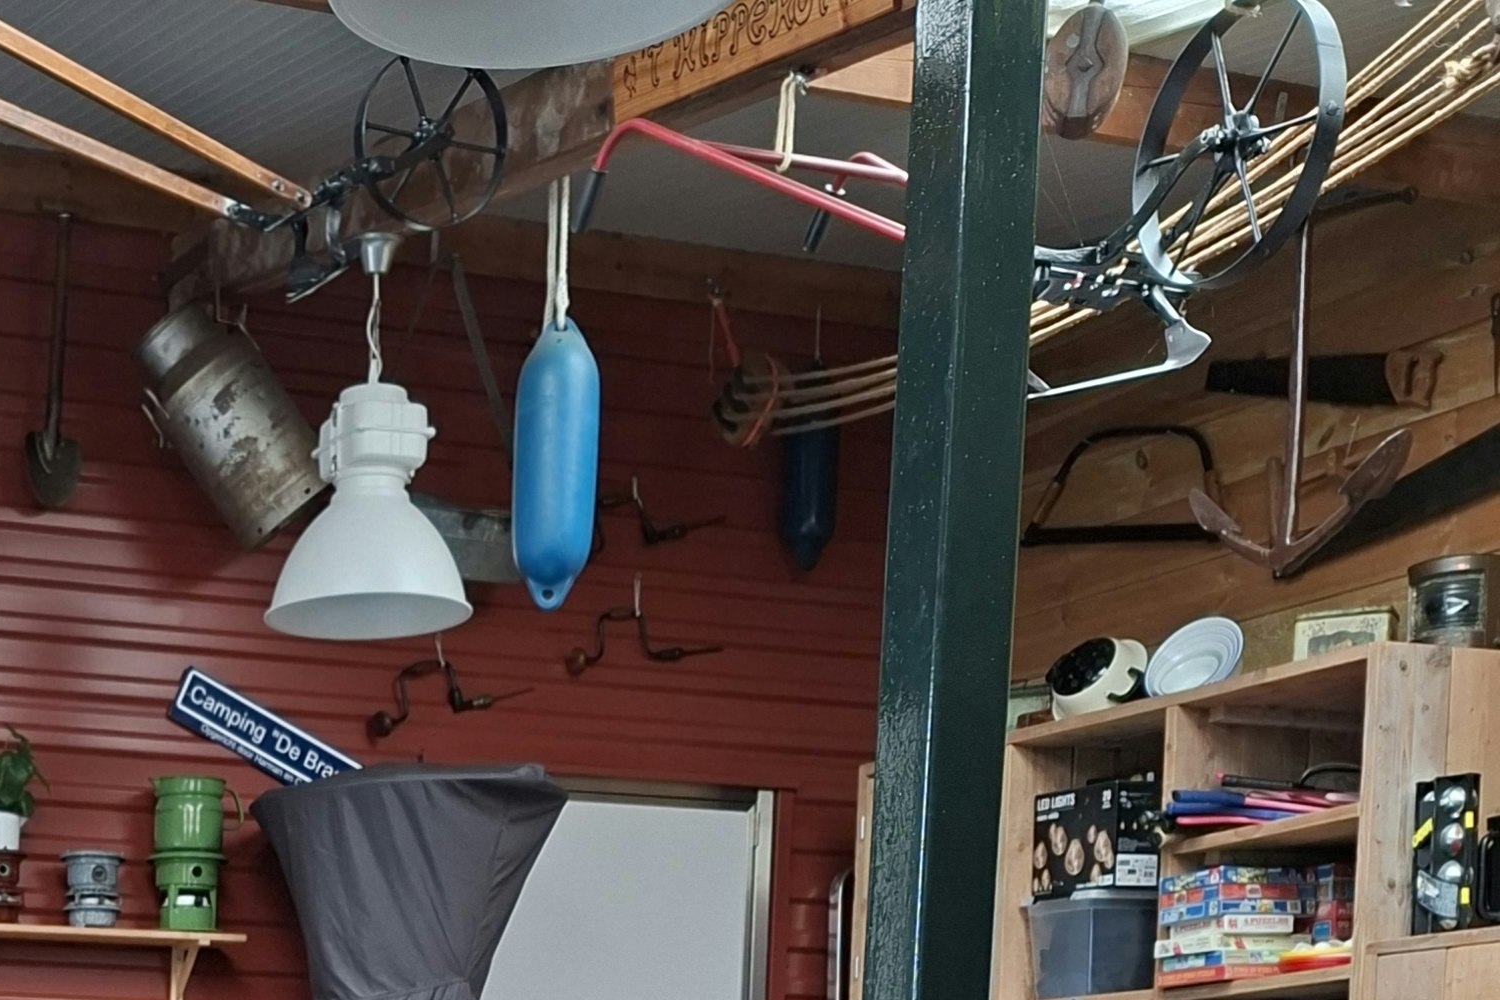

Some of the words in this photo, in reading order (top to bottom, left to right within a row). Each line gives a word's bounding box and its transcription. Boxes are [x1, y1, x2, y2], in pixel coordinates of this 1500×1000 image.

[190, 685, 267, 744] Camping
[271, 727, 301, 762] "De
[303, 749, 340, 779] Bra
[1051, 792, 1076, 809] LIGHTS
